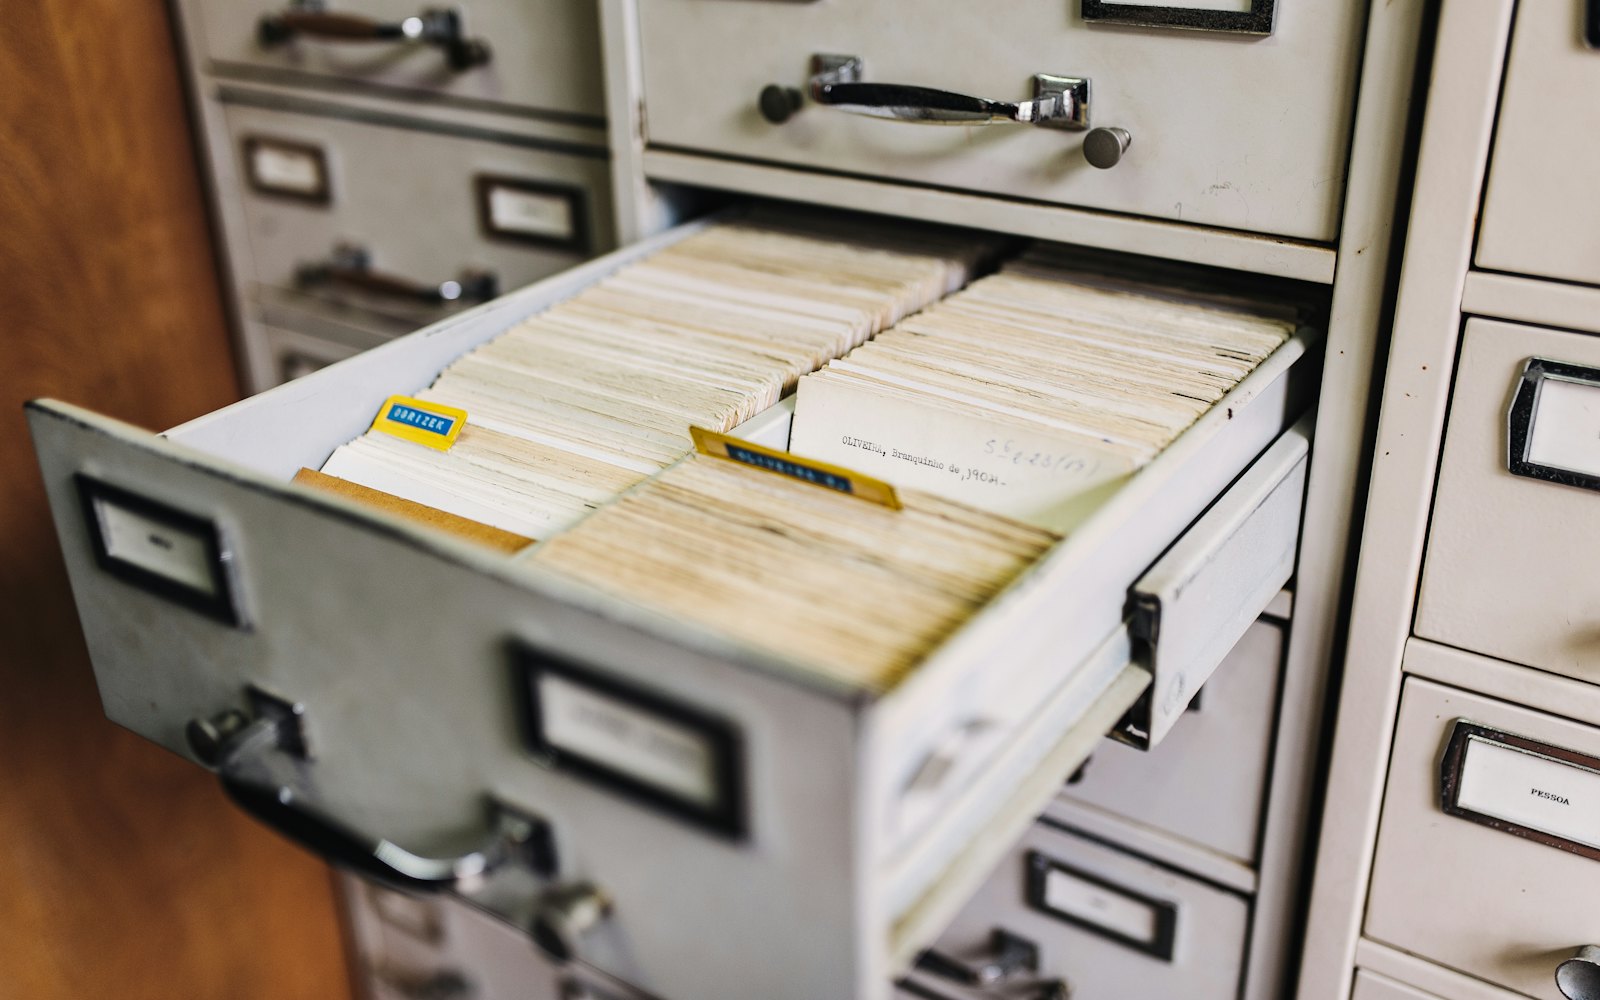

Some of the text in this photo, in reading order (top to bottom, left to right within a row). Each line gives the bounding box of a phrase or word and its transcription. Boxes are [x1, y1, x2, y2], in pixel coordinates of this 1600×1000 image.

[842, 435, 886, 457] OLIVEIRA,
[891, 448, 944, 470] Branquinho
[1531, 788, 1570, 806] PESSOA
